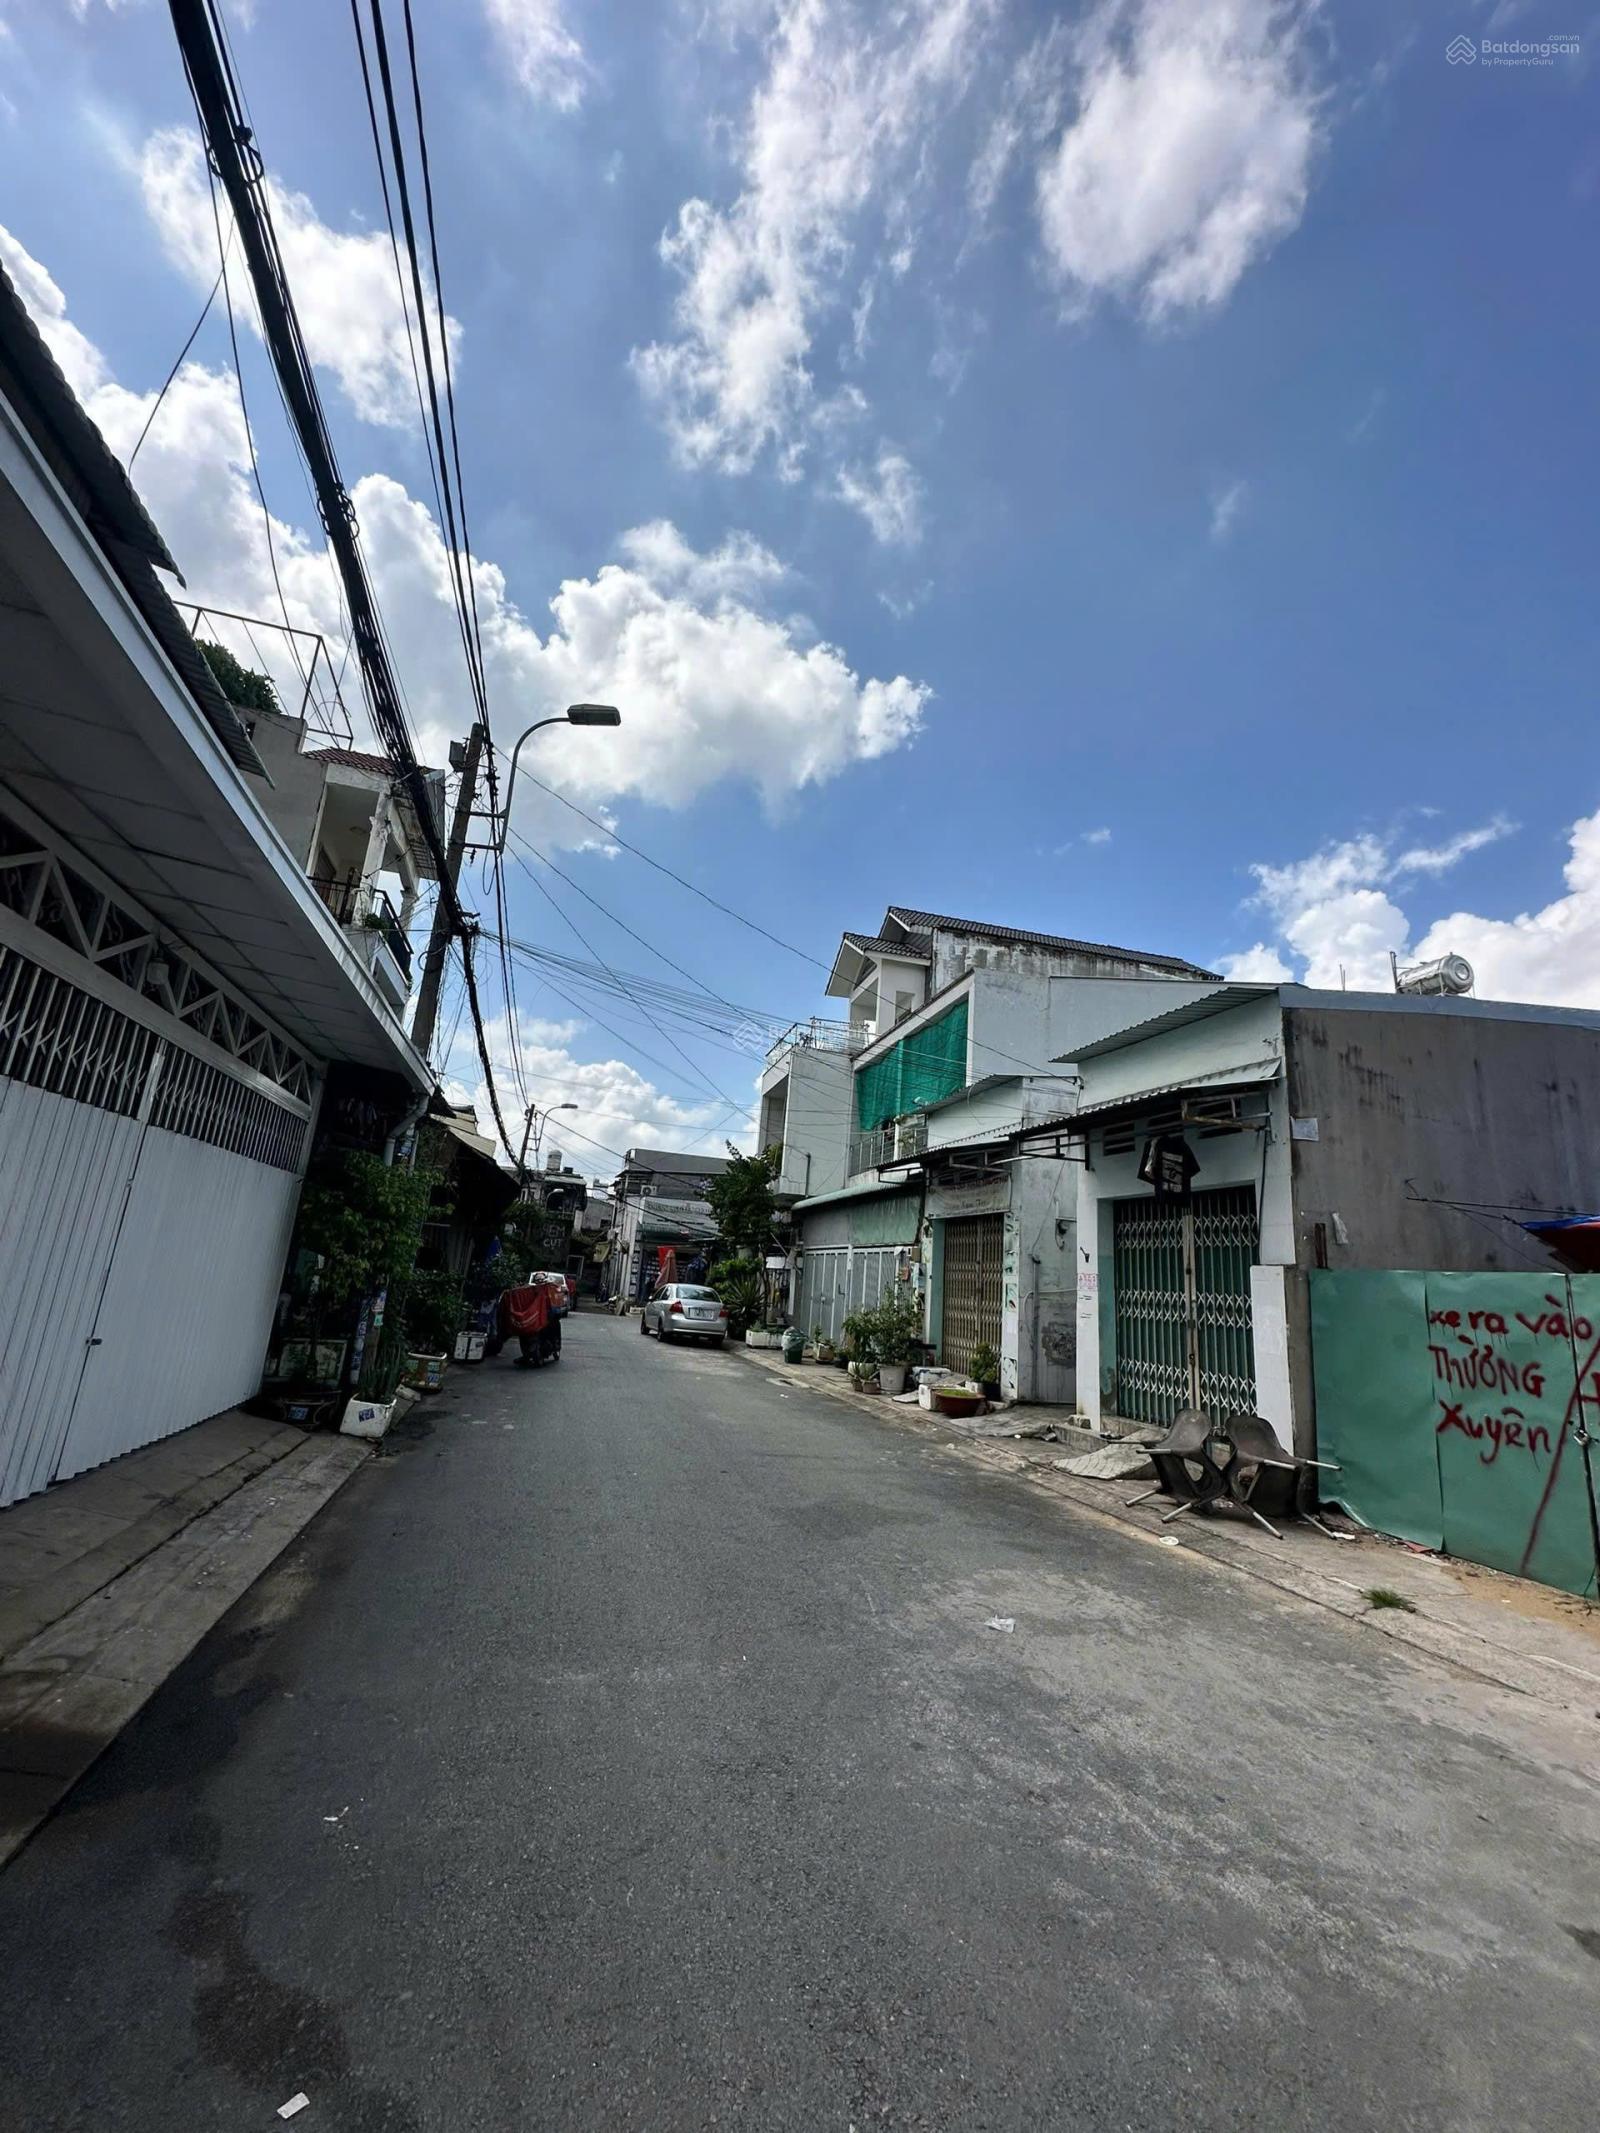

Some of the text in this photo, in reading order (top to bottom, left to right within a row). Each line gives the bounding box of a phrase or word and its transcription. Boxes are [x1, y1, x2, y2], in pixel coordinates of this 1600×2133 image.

[1429, 1294, 1593, 1340] xe ra vào
[1436, 1400, 1551, 1464] Xuyên
